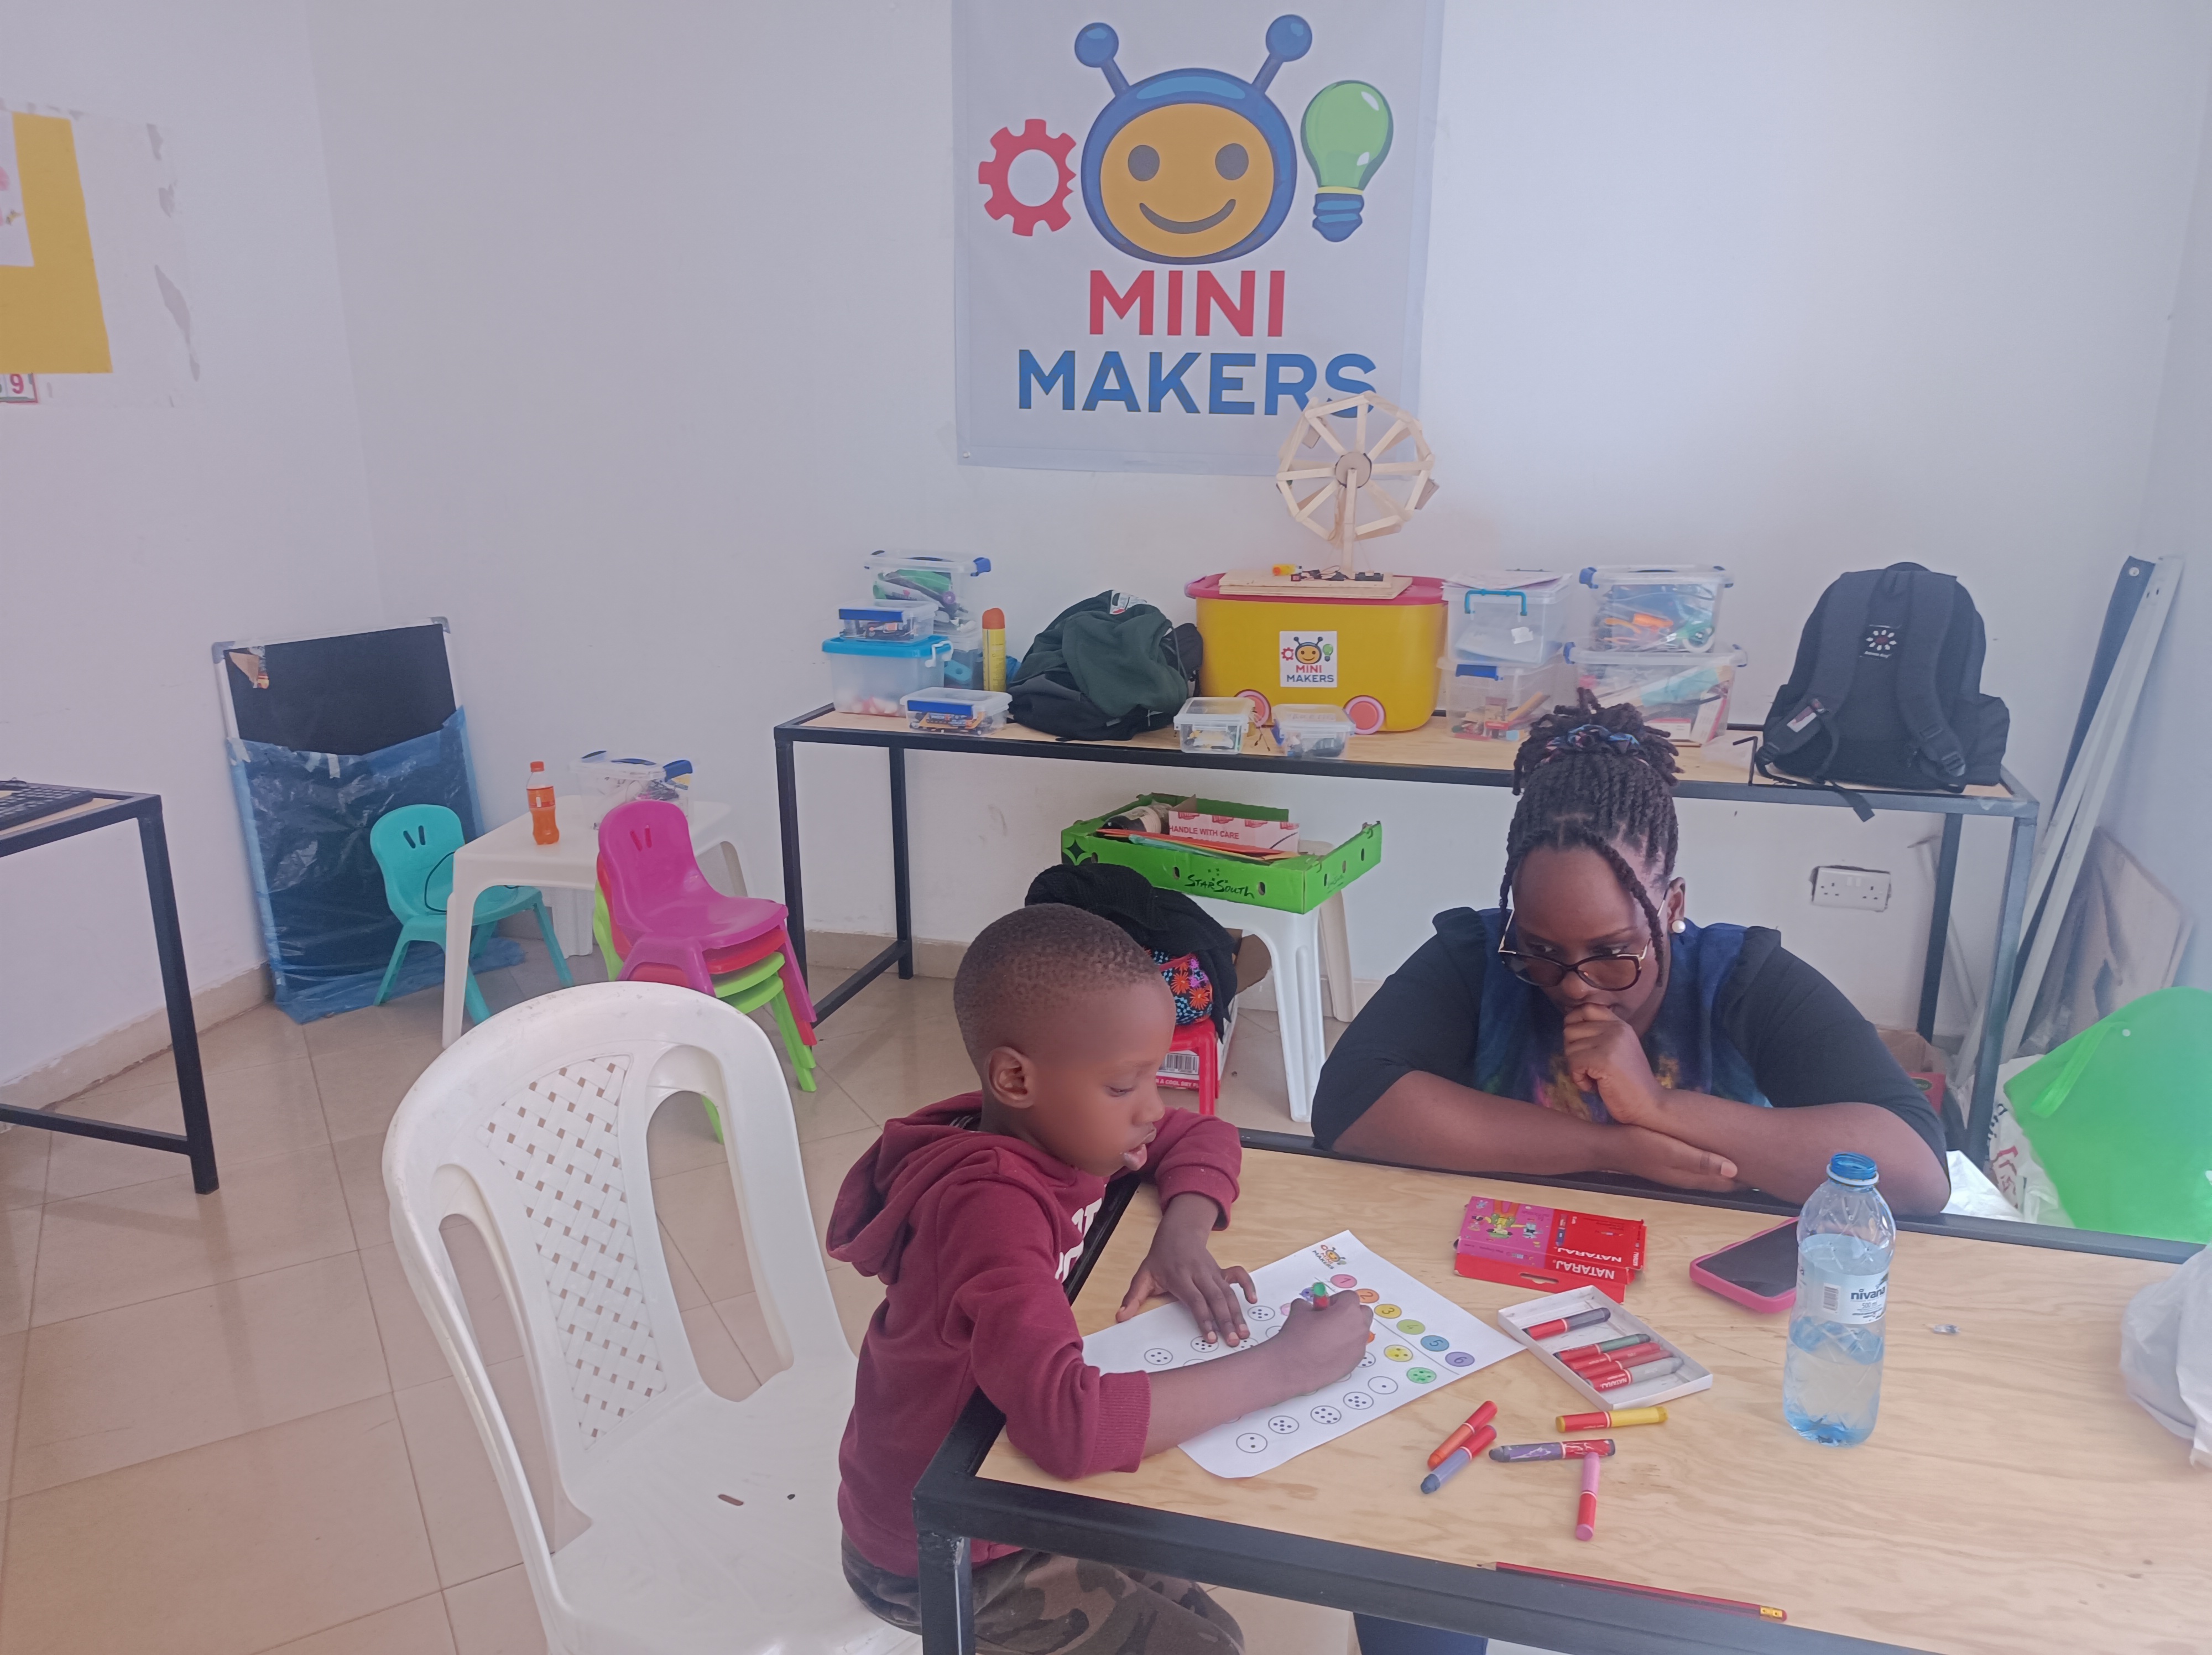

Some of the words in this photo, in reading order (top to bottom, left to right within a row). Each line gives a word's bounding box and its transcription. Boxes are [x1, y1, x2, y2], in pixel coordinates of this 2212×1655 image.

[1089, 270, 1285, 337] MINI
[9, 373, 24, 394] 9
[1019, 349, 1376, 419] MAKERS
[1286, 674, 1334, 683] MAKERS
[1296, 665, 1322, 673] MINI
[1170, 825, 1198, 835] HANDLE
[1199, 828, 1218, 837] WITH
[1220, 830, 1239, 840] CARE
[1557, 1247, 1622, 1263] NATARAJ
[1556, 1260, 1615, 1279] NATARAJ
[1360, 1292, 1374, 1300] 2
[1429, 1339, 1443, 1347] 5
[1453, 1356, 1467, 1364] 6
